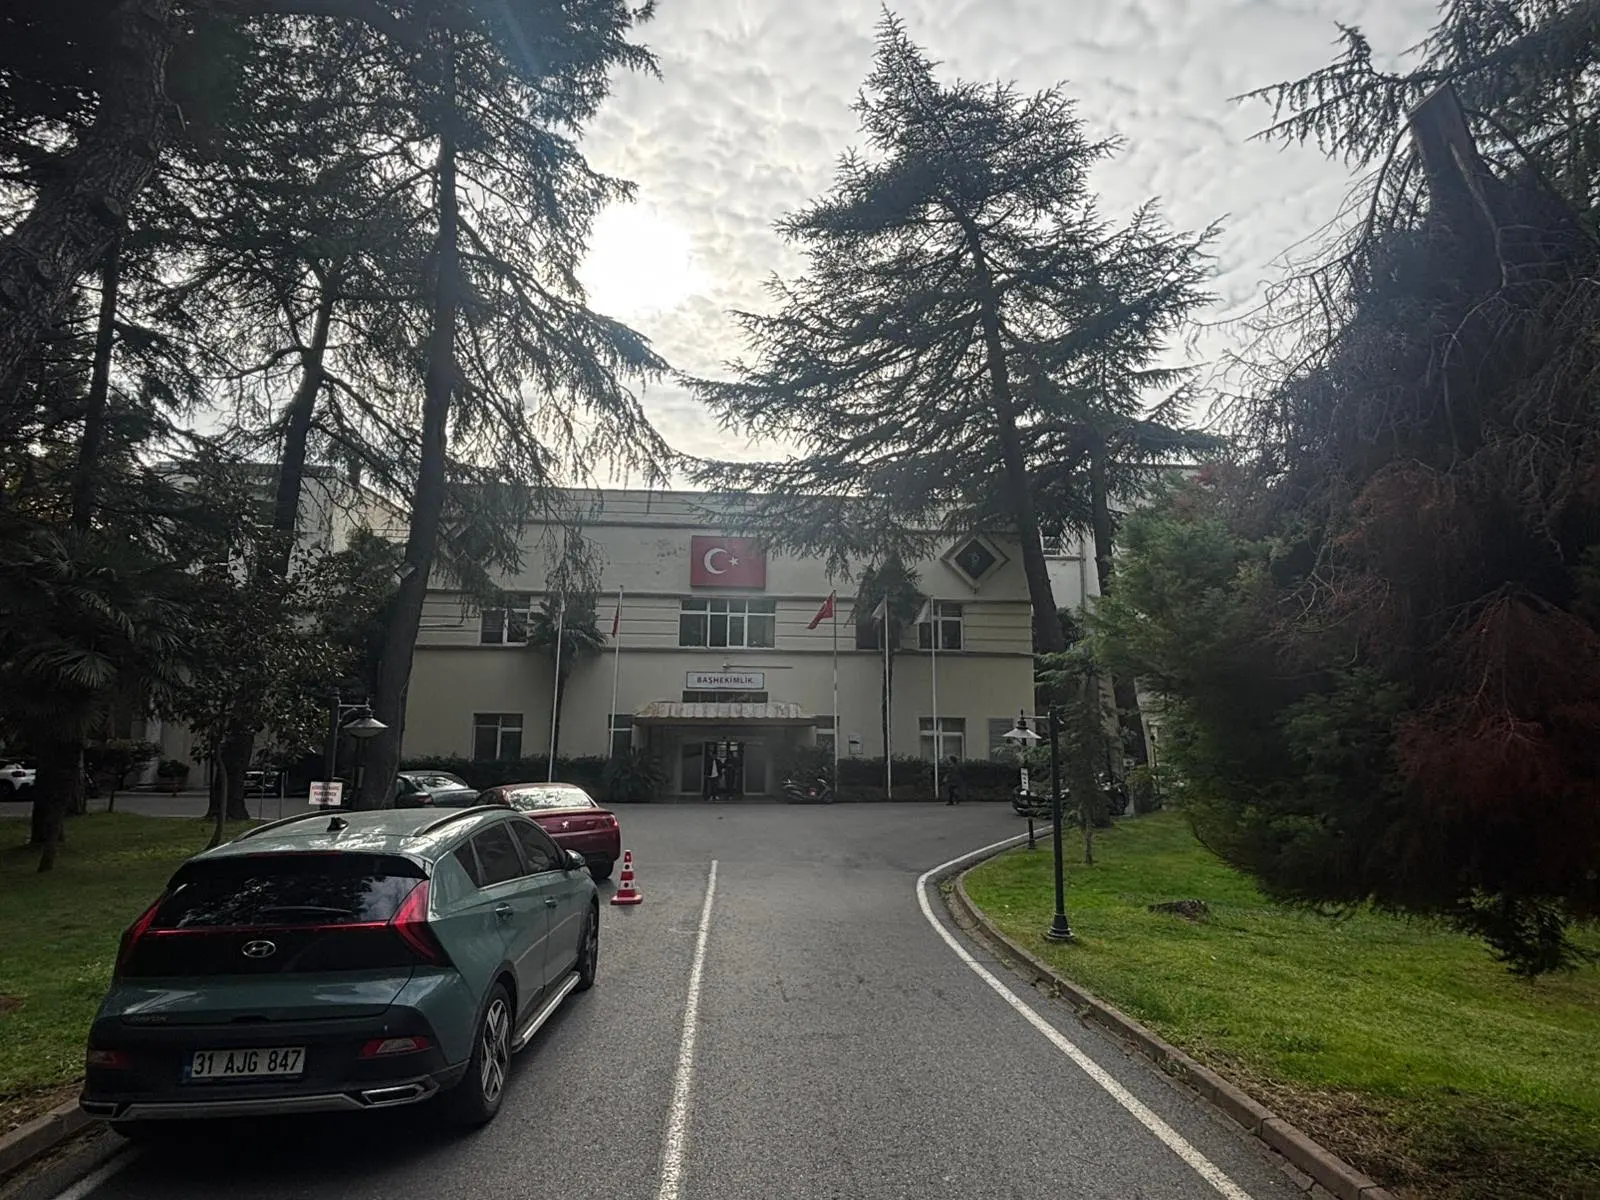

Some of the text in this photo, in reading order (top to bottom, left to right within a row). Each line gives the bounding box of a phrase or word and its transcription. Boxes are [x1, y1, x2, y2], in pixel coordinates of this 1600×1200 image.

[697, 676, 754, 685] BAŞHEKİMLİK
[194, 1048, 303, 1075] 31 AJG 847
